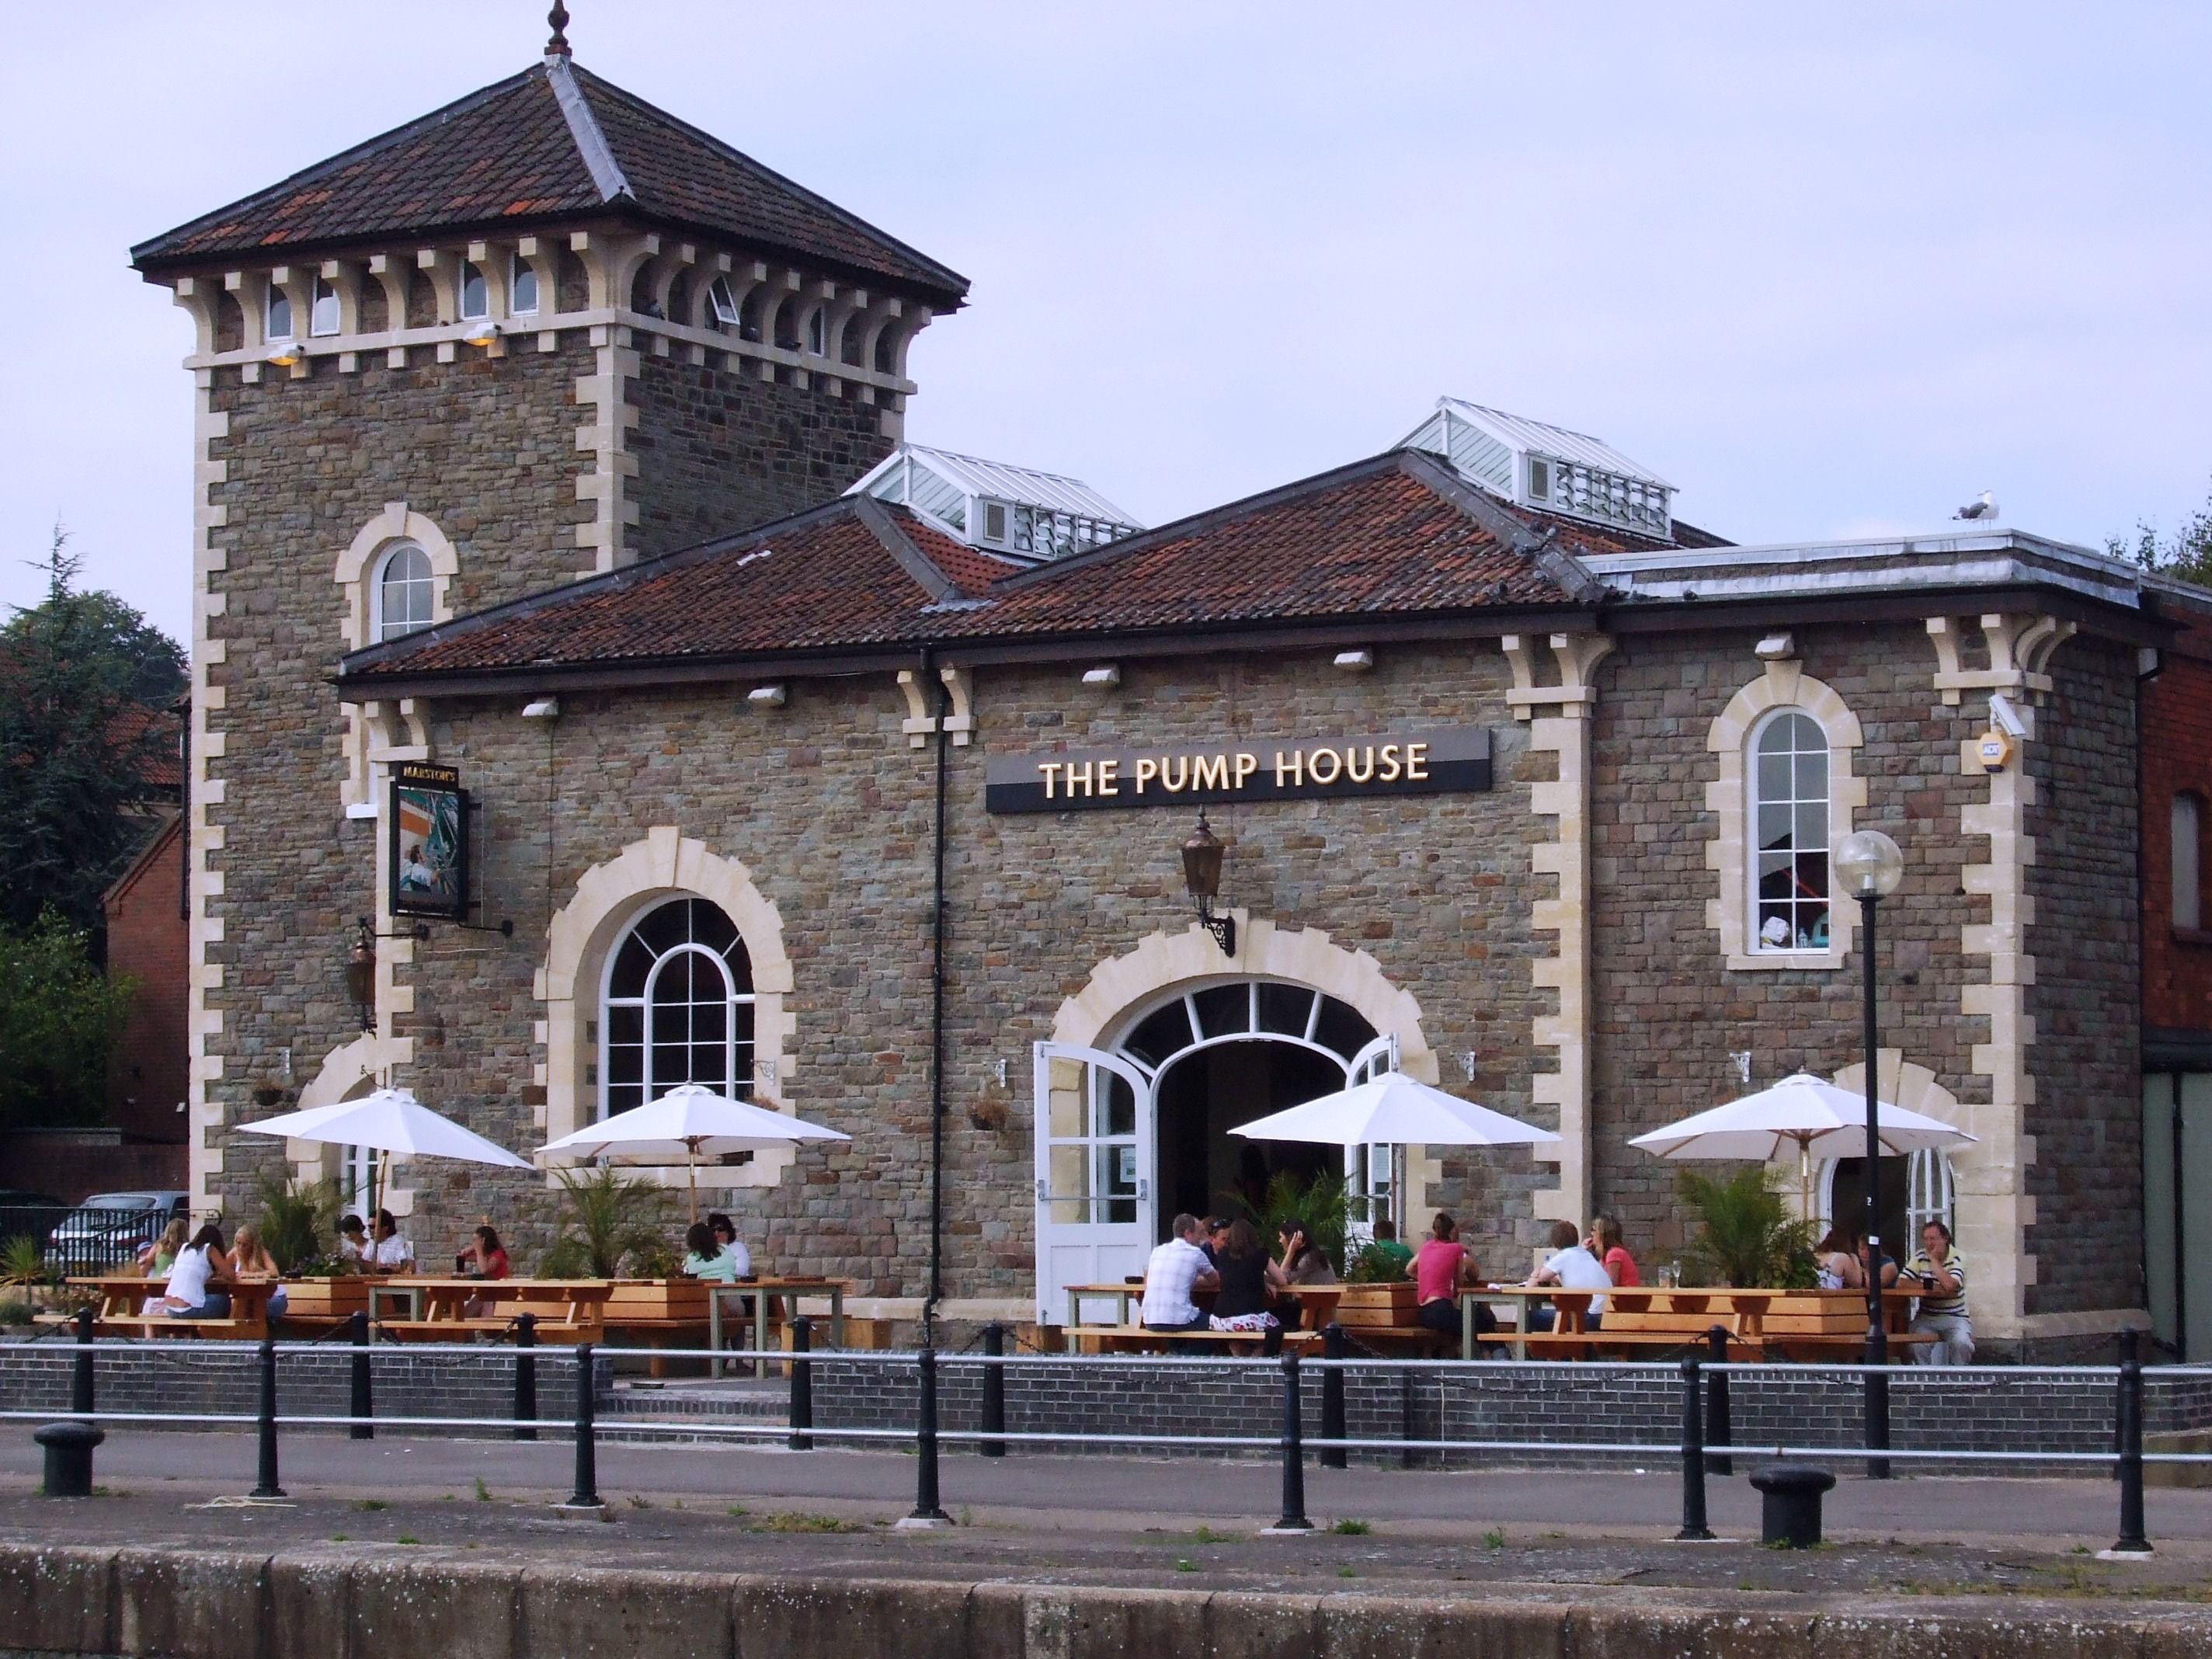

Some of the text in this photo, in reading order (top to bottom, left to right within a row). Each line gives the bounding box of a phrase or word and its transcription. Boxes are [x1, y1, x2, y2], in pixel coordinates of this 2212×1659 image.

[1038, 743, 1429, 798] THE PUMP HOUSE
